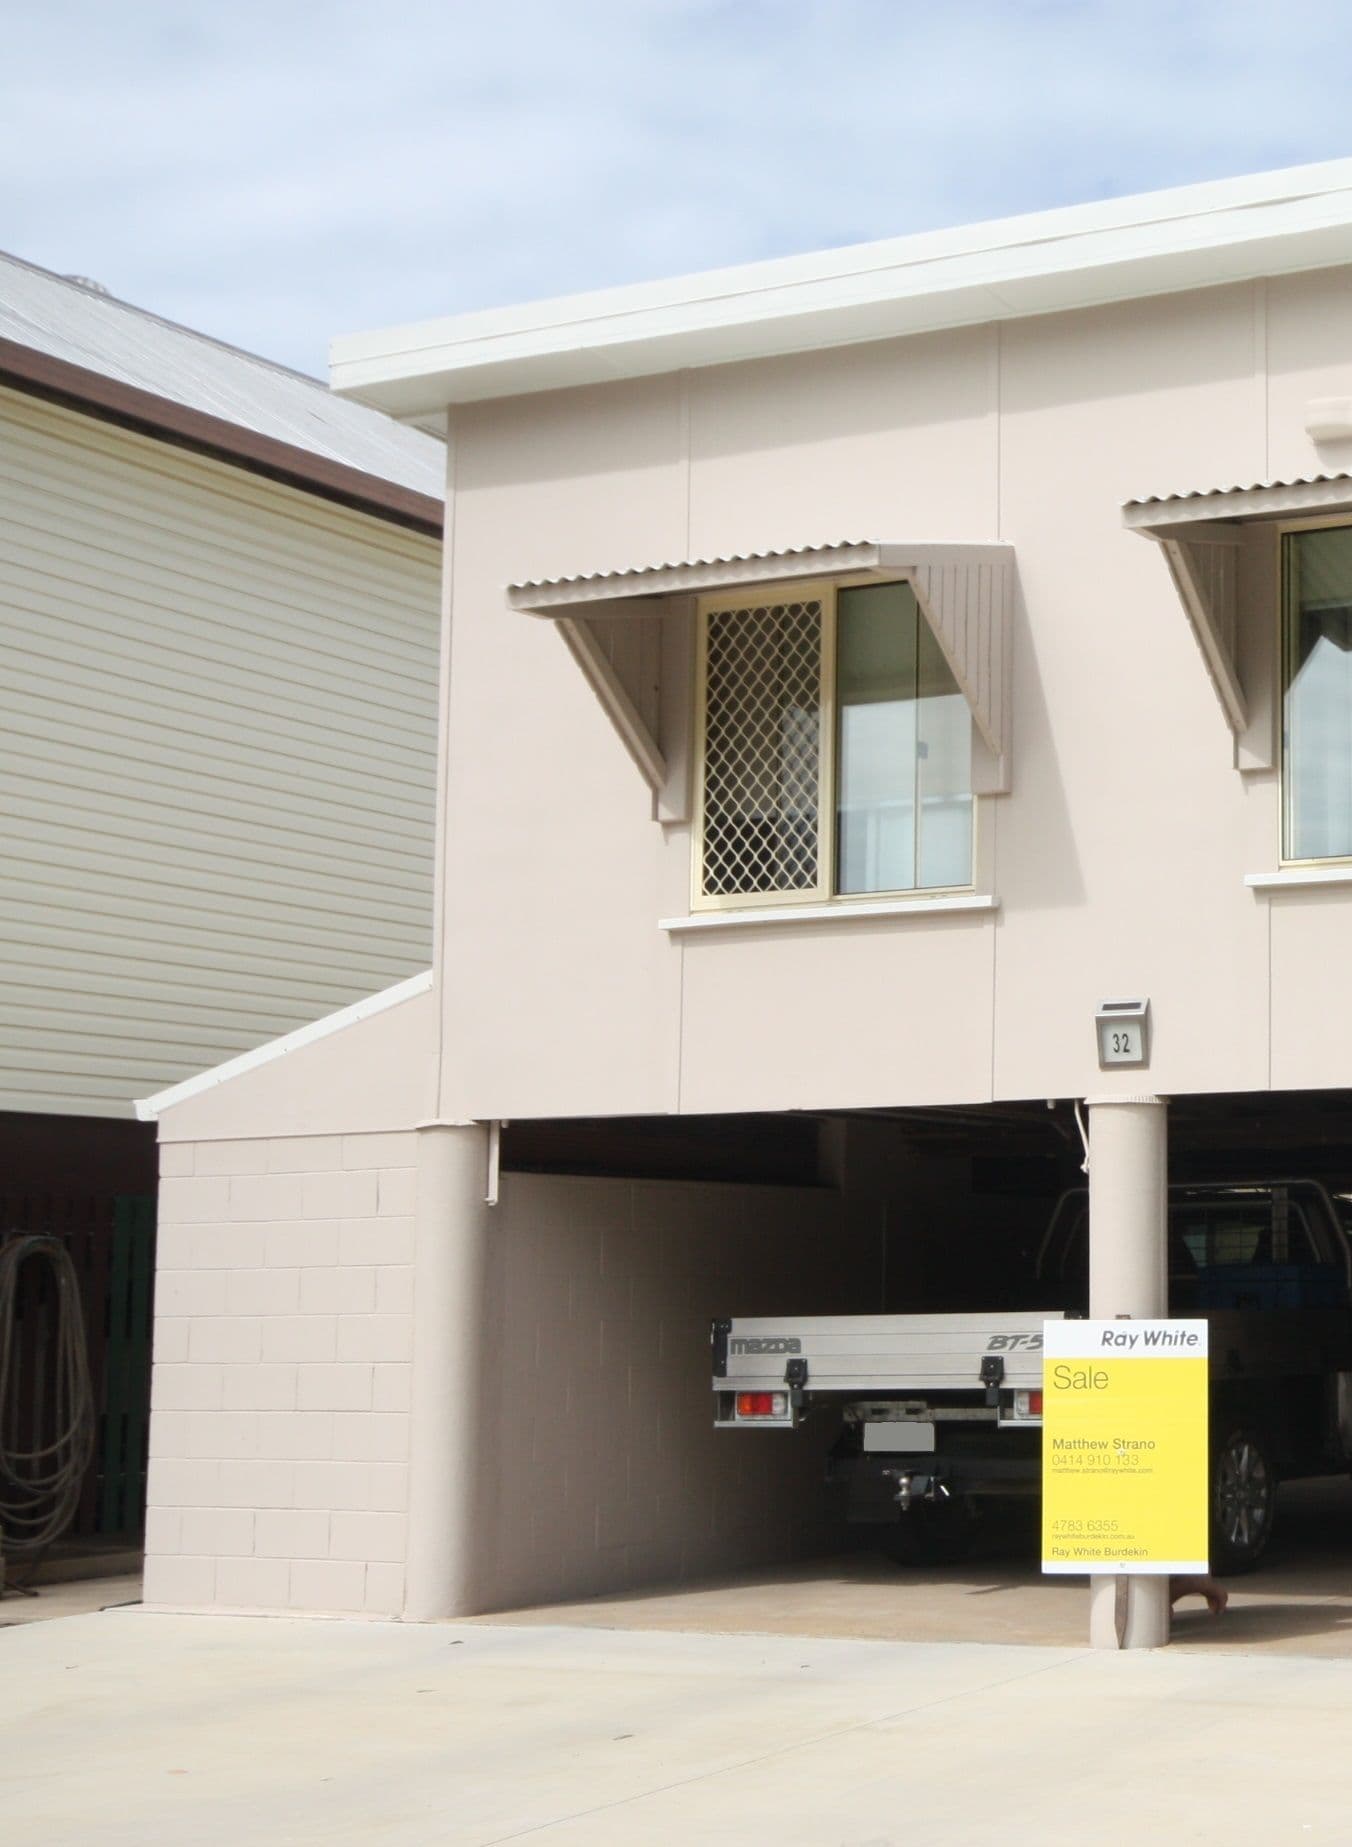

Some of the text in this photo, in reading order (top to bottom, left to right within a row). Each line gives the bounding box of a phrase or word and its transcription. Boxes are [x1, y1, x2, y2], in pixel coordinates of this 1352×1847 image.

[1112, 1033, 1130, 1053] 32
[987, 1334, 1043, 1351] BT-5
[1101, 1330, 1199, 1349] Ray White
[1053, 1364, 1109, 1390] Sale
[1052, 1438, 1156, 1450] Matthew Strano
[1052, 1454, 1140, 1466] 0414 910 133
[1052, 1520, 1119, 1532] 4783 6355
[1052, 1546, 1149, 1558] Ray White Burdekin
